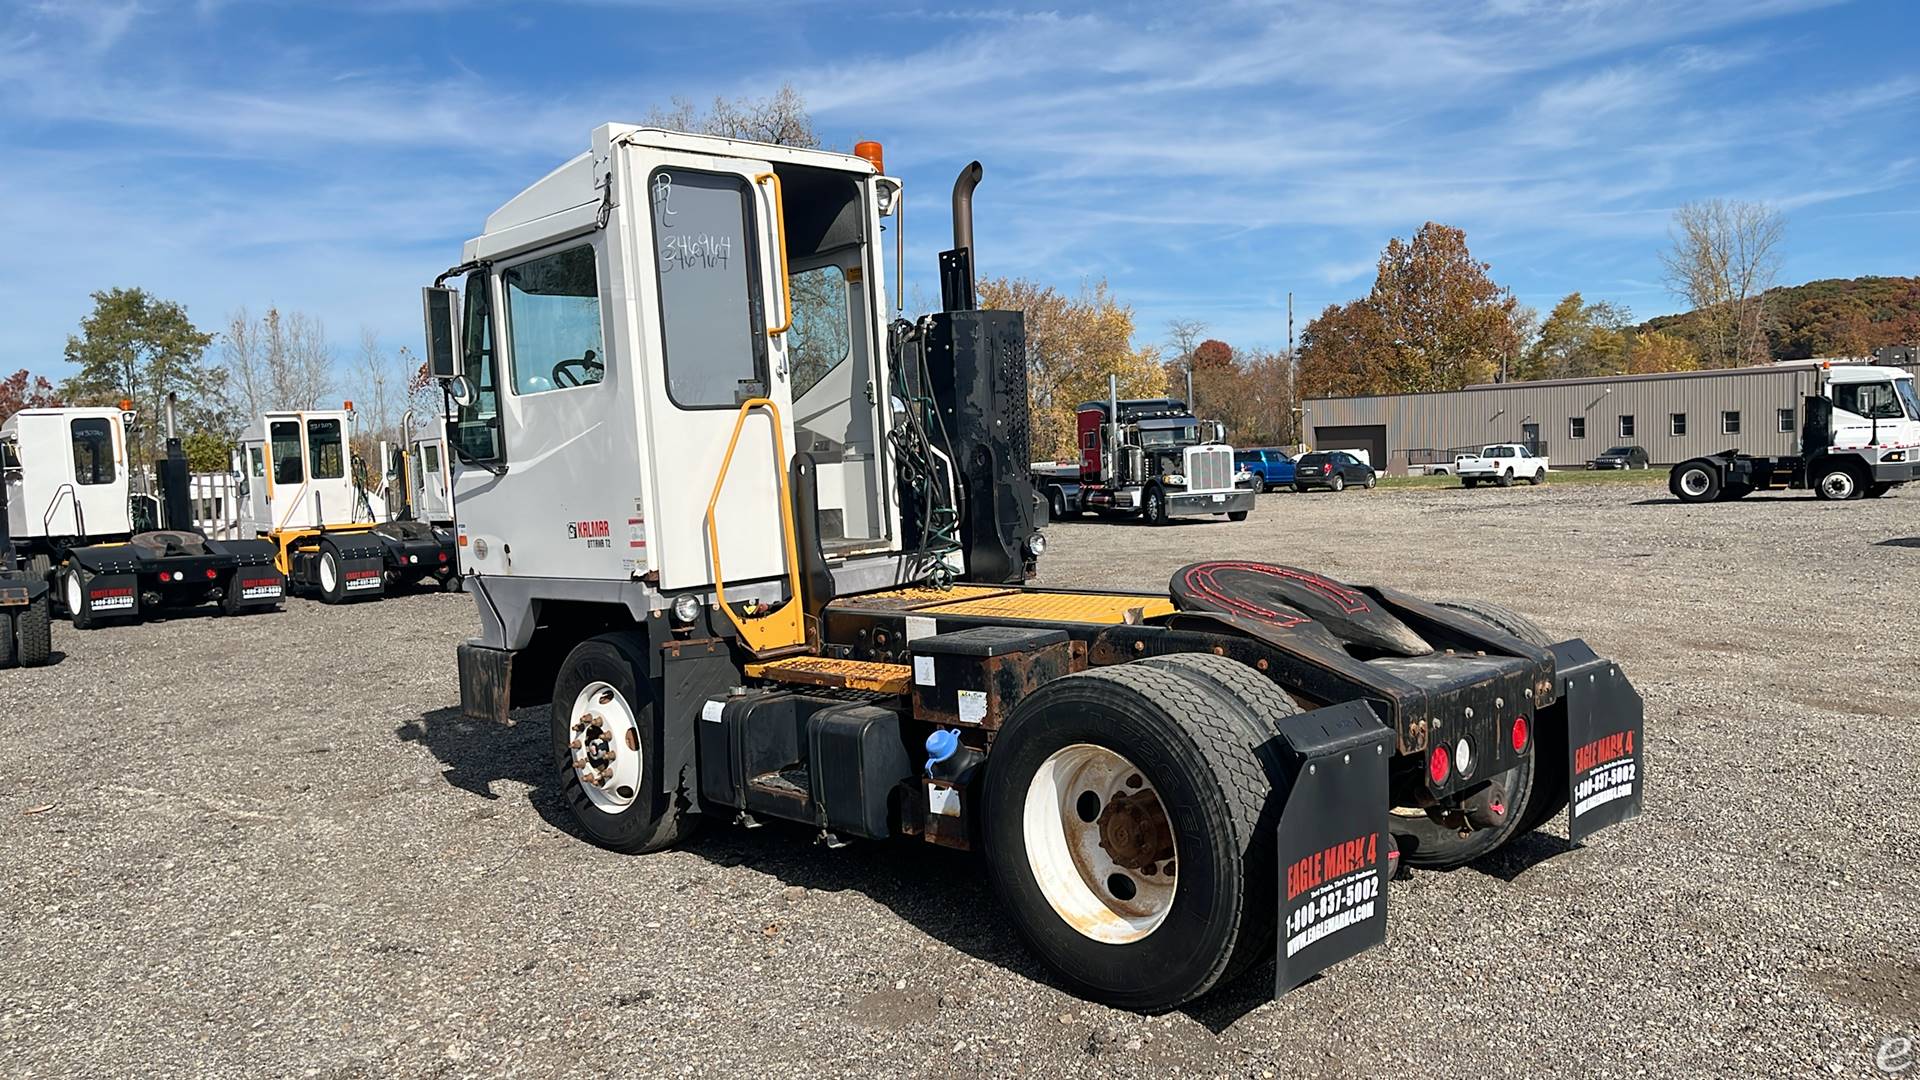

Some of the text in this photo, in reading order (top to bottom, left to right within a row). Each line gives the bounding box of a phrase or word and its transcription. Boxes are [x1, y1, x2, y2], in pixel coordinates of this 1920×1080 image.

[577, 520, 610, 538] KALMAR
[1575, 741, 1599, 775] EAGLE
[1598, 731, 1624, 764] MARK
[1625, 730, 1633, 755] 4
[1288, 833, 1378, 901] EAGLE MARK 4
[1286, 876, 1379, 938] 1-800-837-5002
[1287, 900, 1375, 958] WWW.EAGLEMARK4.COM
